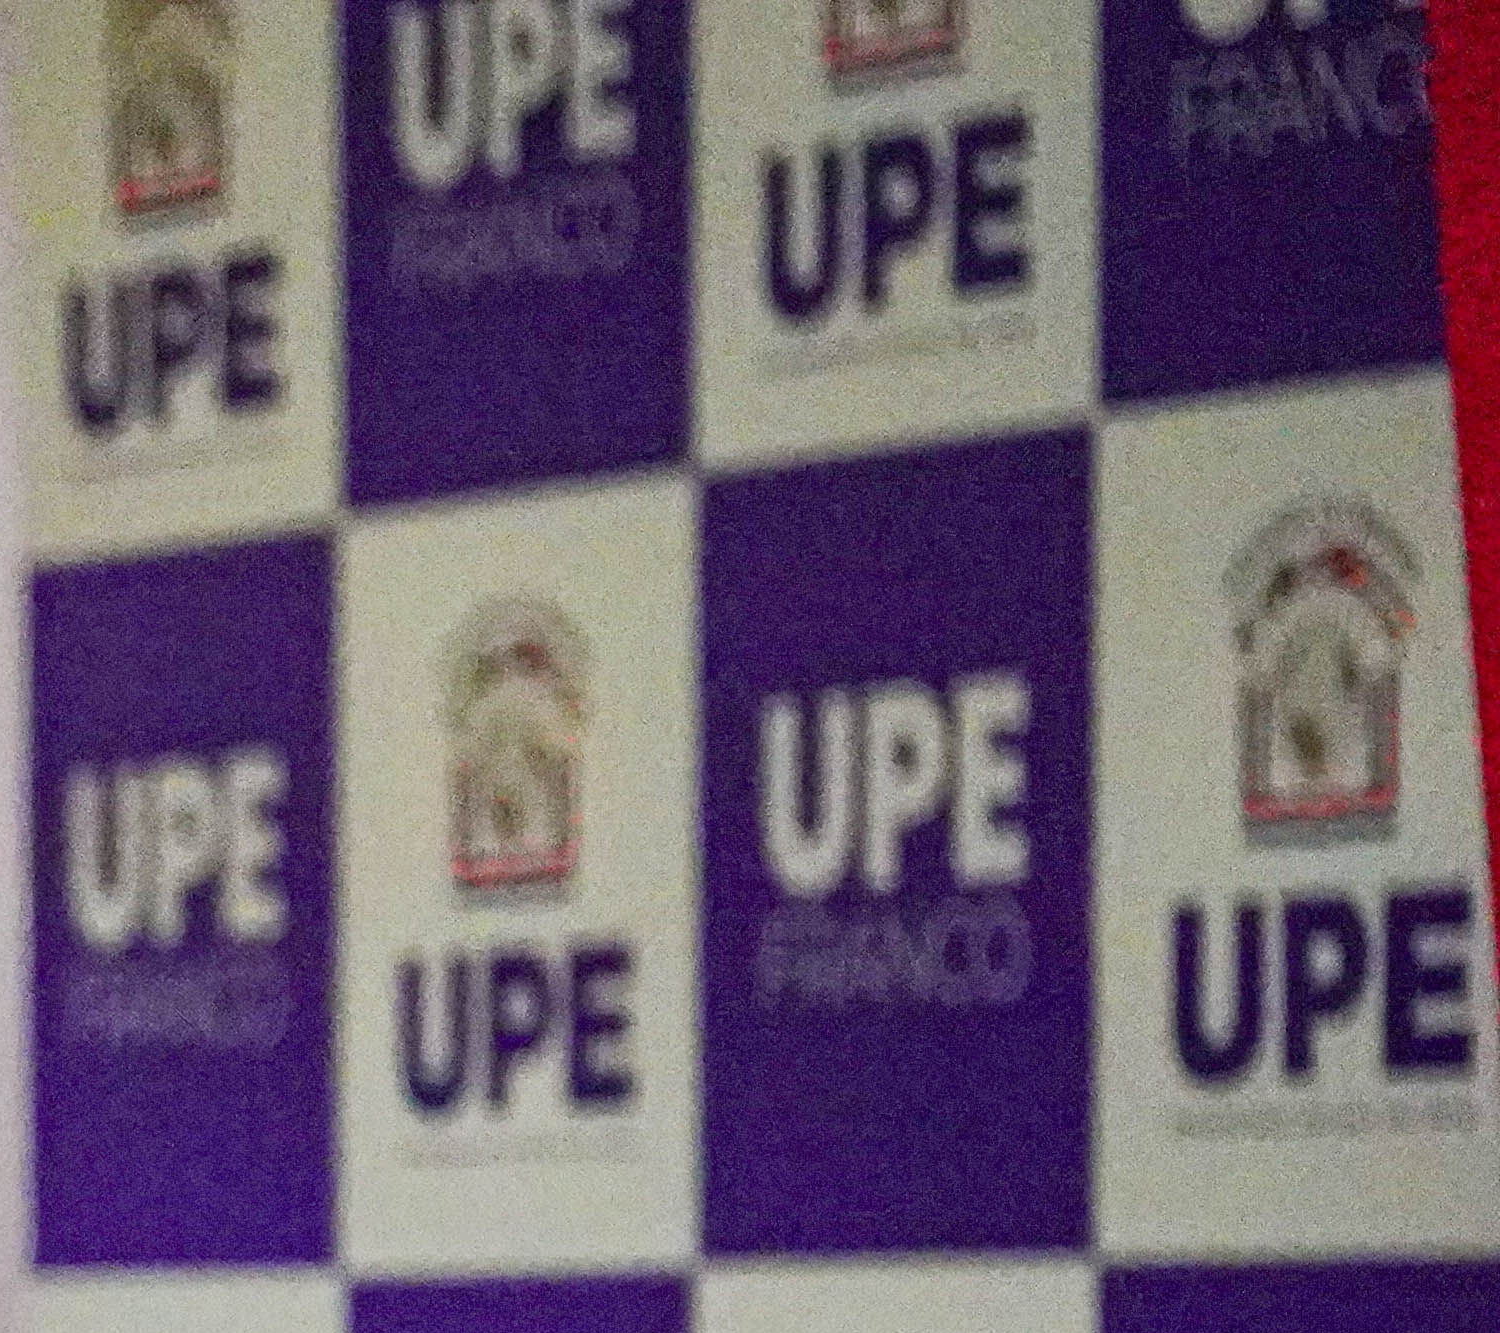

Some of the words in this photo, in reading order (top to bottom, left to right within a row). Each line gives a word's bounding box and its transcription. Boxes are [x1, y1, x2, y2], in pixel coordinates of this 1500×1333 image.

[395, 0, 633, 188] UPE
[762, 108, 1030, 324] UPE
[64, 247, 284, 438] UPE
[67, 750, 286, 950] UPE
[763, 676, 1030, 897] UPE
[400, 940, 635, 1117] UPE
[1170, 882, 1474, 1088] UPE
